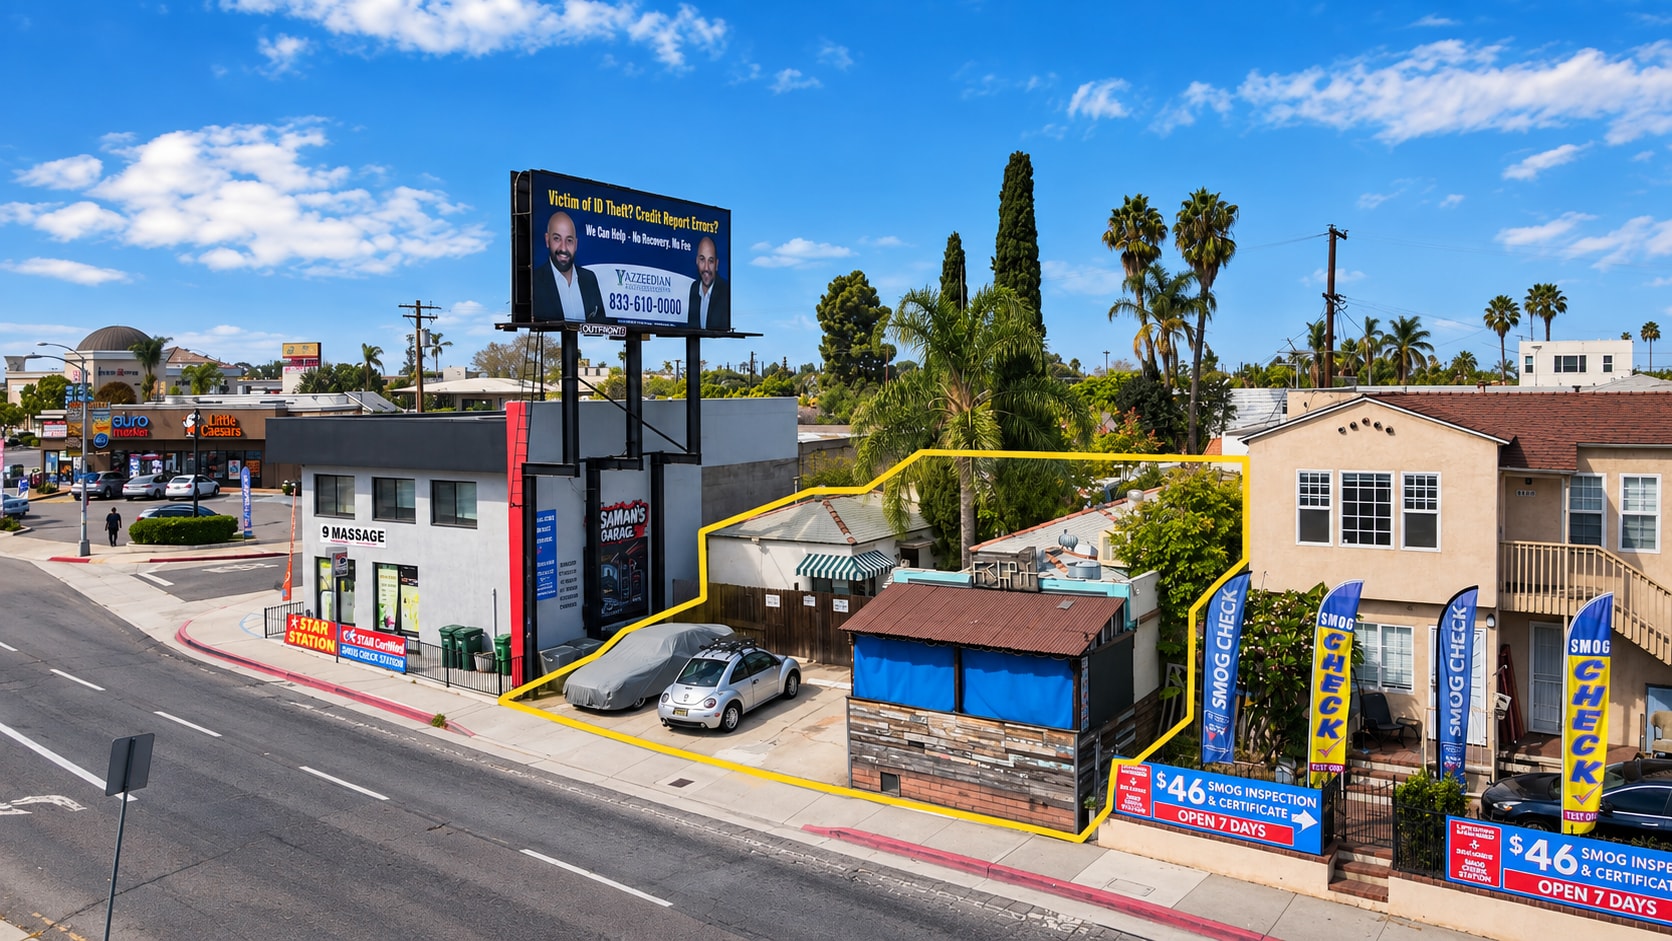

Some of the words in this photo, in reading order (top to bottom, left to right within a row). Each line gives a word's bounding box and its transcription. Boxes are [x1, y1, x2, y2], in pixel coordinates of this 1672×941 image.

[548, 190, 579, 210] Victim
[582, 196, 592, 212] of
[594, 198, 603, 214] ID
[606, 200, 634, 218] Theft?
[636, 206, 662, 224] Credit
[664, 213, 690, 230] Report
[692, 216, 718, 234] Errors?
[586, 224, 596, 237] We
[598, 226, 610, 239] Can
[612, 228, 626, 244] Help
[632, 231, 641, 243] No
[681, 240, 692, 251] Fee
[616, 269, 671, 286] YAZZEEDIAN
[610, 292, 681, 315] 833-610-0000
[201, 425, 241, 437] Caesars
[209, 414, 236, 426] Little
[601, 504, 646, 528] SAMAN'S
[322, 526, 329, 538] 9
[332, 526, 385, 542] MASSAGE
[300, 618, 328, 635] STAR
[1216, 588, 1238, 651] CHECK
[1321, 612, 1354, 630] SMOG
[289, 630, 335, 652] STATION
[1450, 605, 1467, 673] CHECK
[1571, 639, 1610, 654] SMOG
[1213, 653, 1230, 710] SMOG
[1316, 632, 1346, 739] CHECK
[1450, 676, 1464, 737] SMOG
[1570, 660, 1605, 784] CHECK
[1208, 781, 1242, 796] SMOG
[1246, 788, 1317, 808] INSPECTION
[1208, 796, 1216, 806] &
[1219, 798, 1287, 819] CERTIFICATE
[1178, 809, 1215, 828] OPEN
[1219, 817, 1227, 829] 7
[1230, 819, 1266, 838] DAYS
[1581, 848, 1626, 866] SMOG
[1581, 865, 1591, 877] &
[1538, 879, 1587, 902] OPEN
[1594, 890, 1604, 904] 7
[1609, 893, 1657, 916] DAYS
